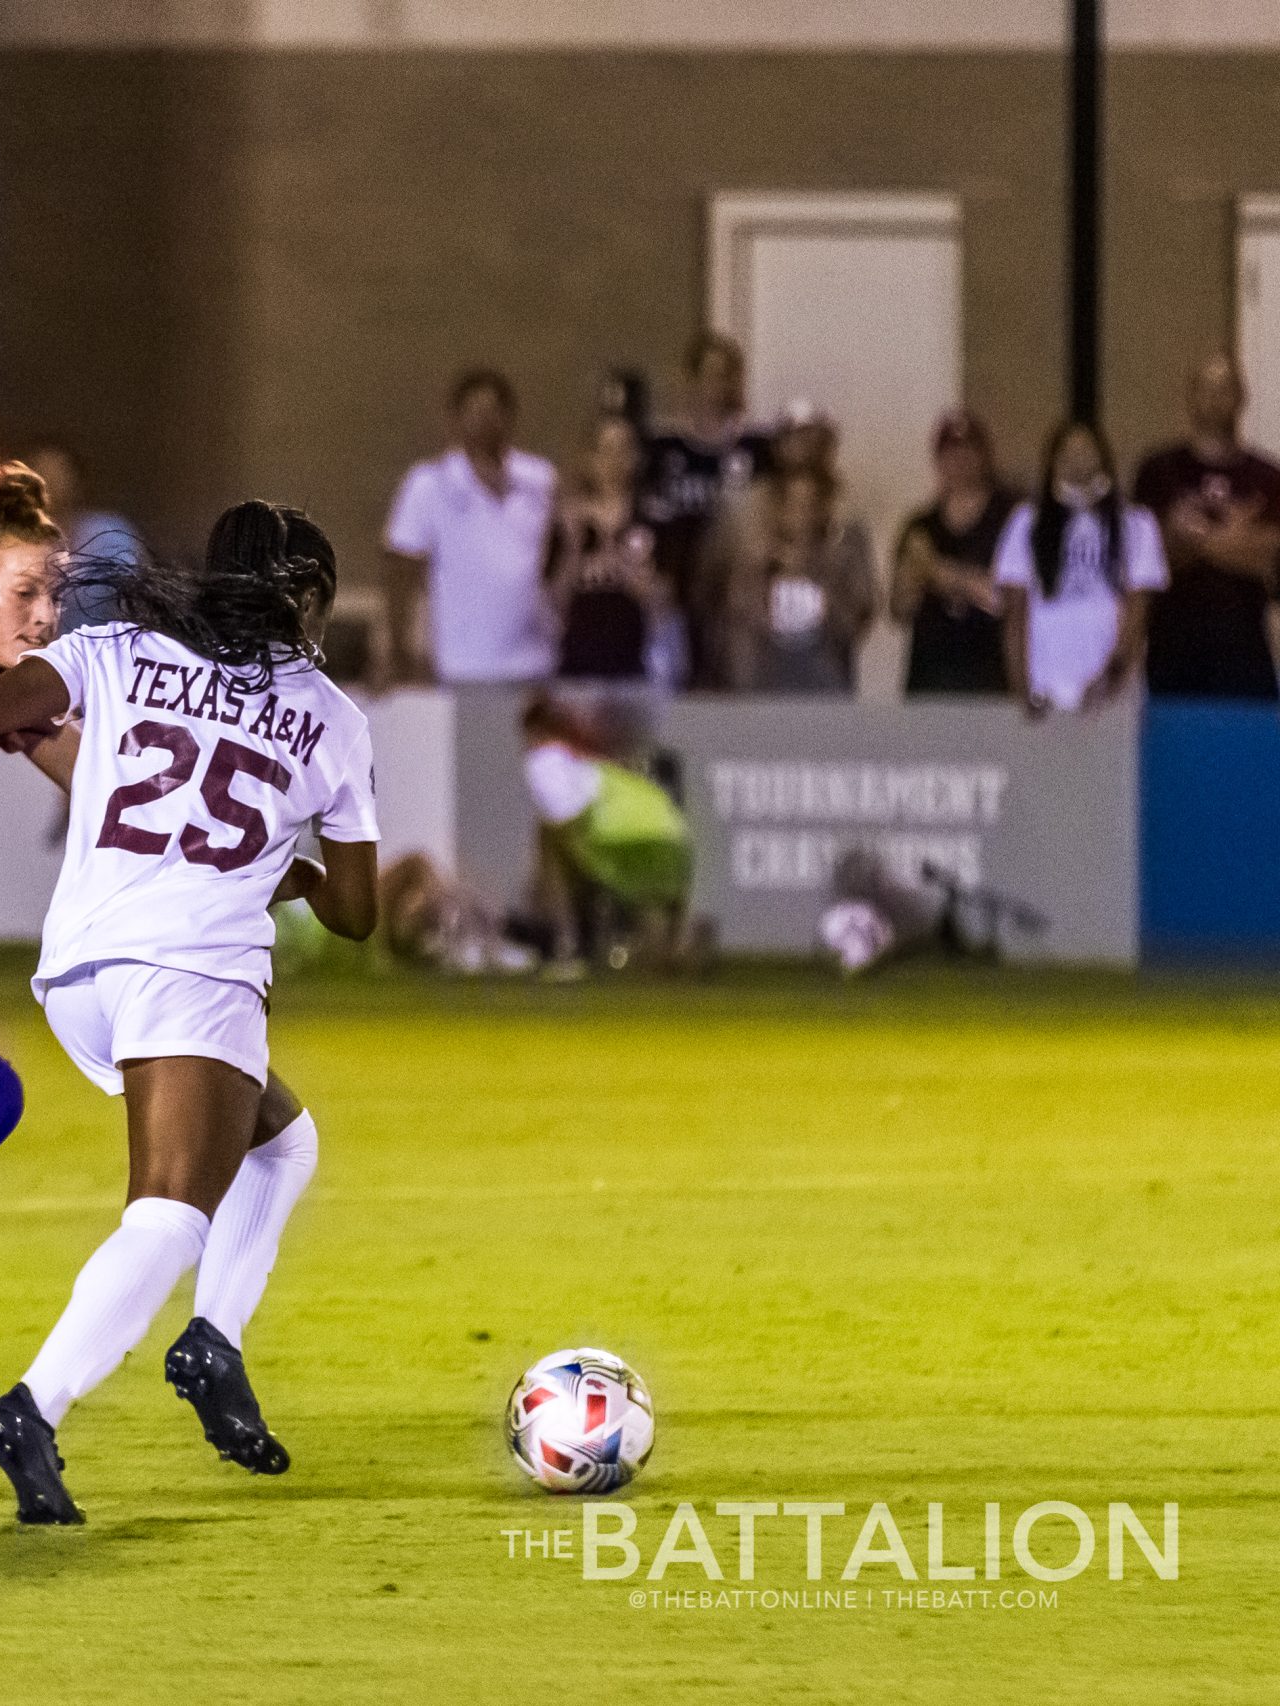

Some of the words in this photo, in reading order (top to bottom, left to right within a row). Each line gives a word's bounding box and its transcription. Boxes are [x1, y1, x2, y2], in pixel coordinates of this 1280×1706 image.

[126, 656, 246, 726] TEXAS
[248, 693, 326, 767] A&M
[95, 719, 293, 873] 25
